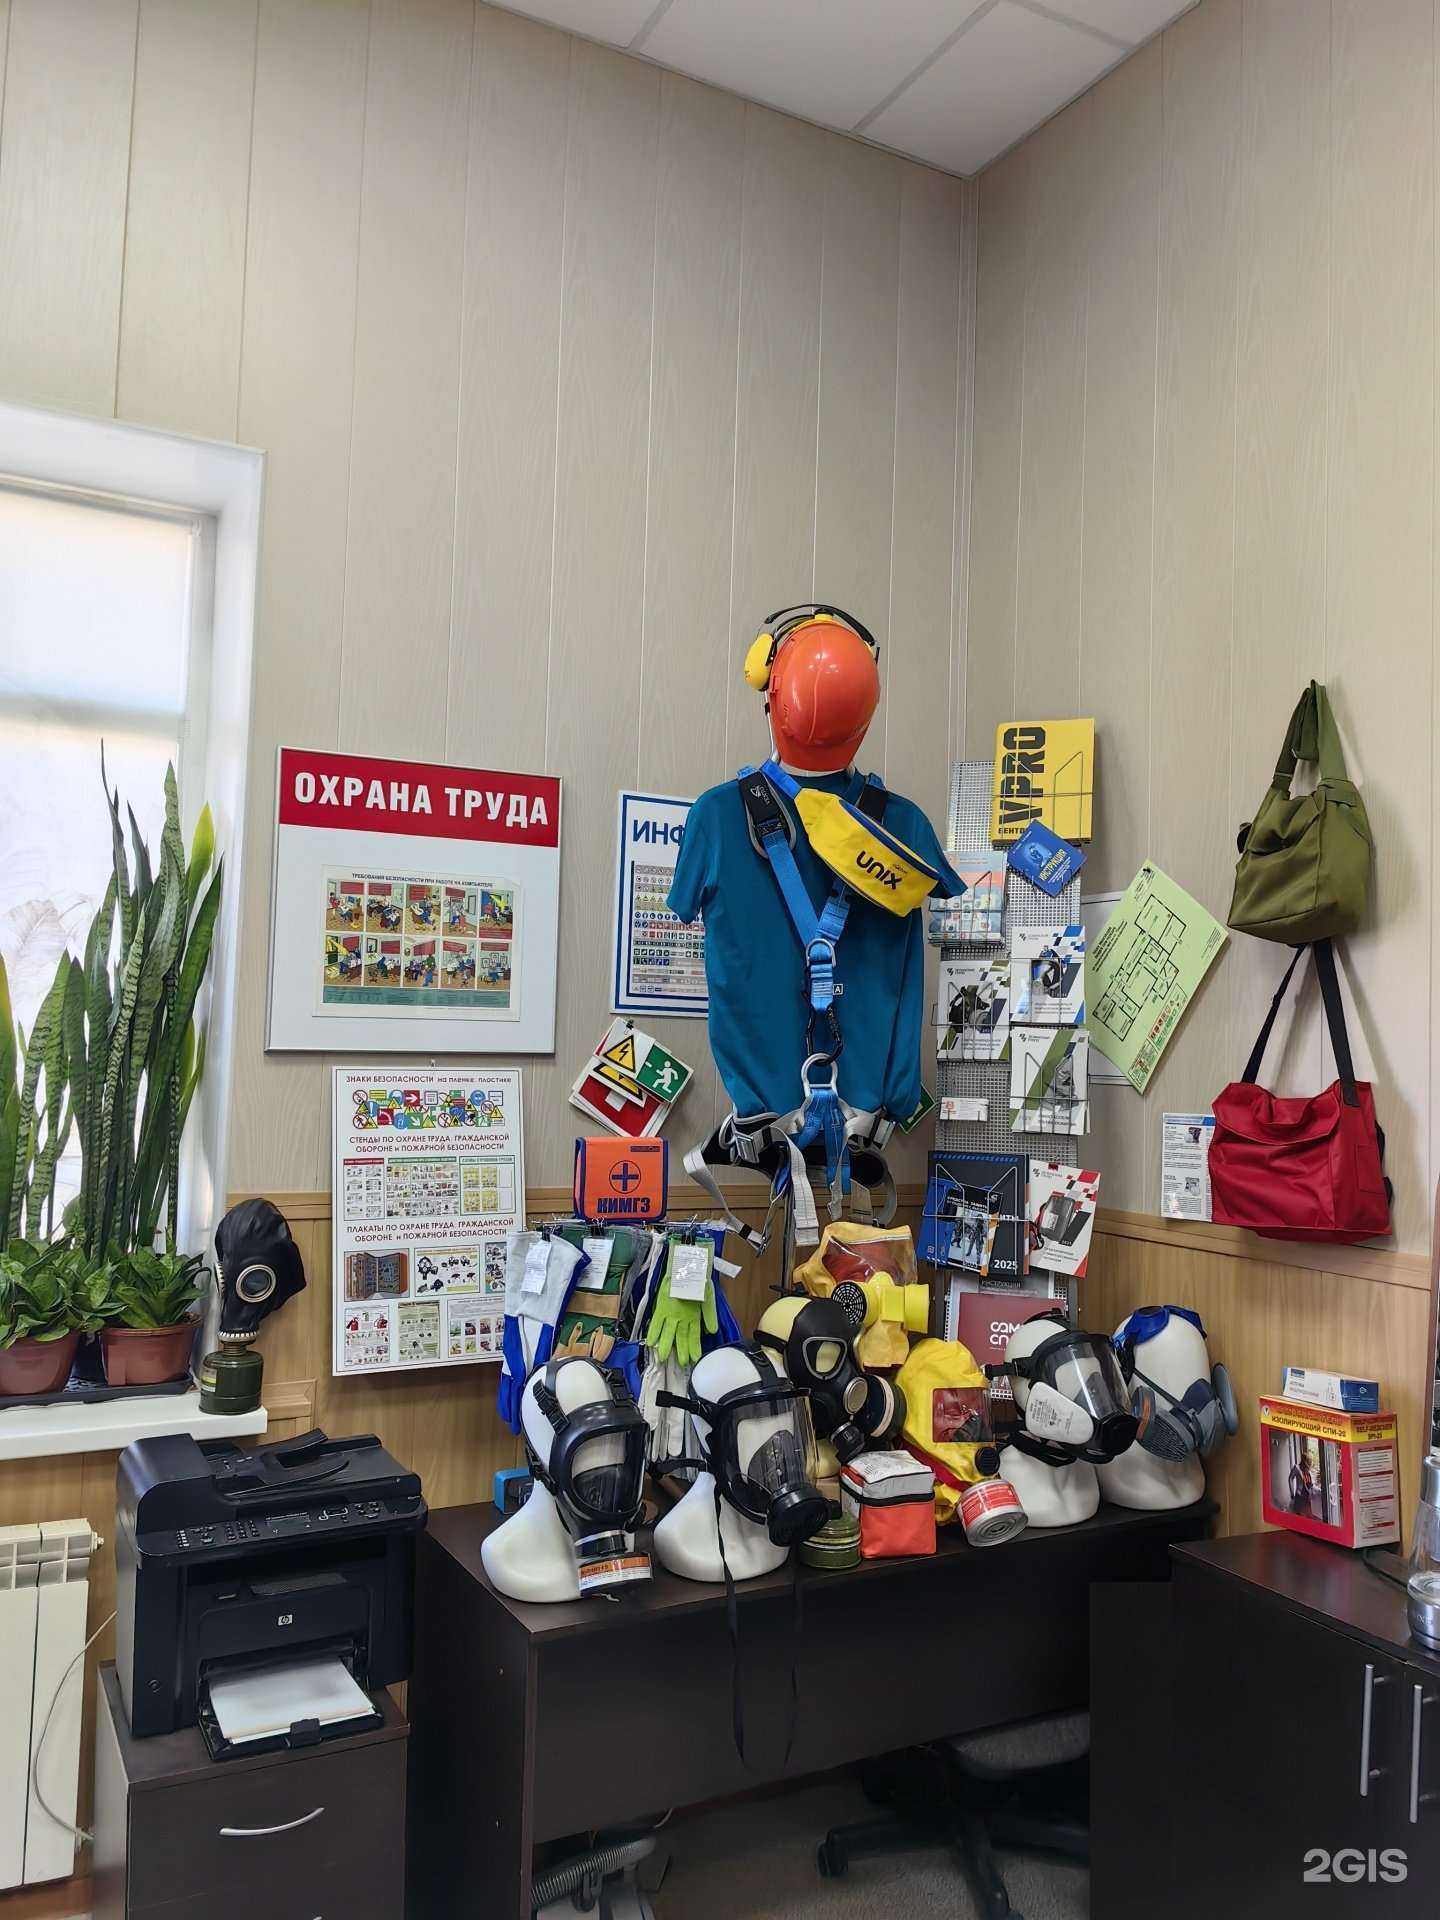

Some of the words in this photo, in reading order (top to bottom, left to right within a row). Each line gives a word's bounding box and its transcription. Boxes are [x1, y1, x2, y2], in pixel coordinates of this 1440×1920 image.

[999, 727, 1045, 824] VPRO
[295, 772, 432, 814] ОХРАНА
[445, 787, 548, 829] ТРУДА
[346, 1075, 372, 1083] ЗНАКИ
[374, 1075, 434, 1083] БЕЗОПАСНОСТИ
[350, 1136, 380, 1144] СТЕНДЫ
[383, 1135, 394, 1143] ПО
[396, 1135, 427, 1143] ОХРАНЕ
[455, 1132, 510, 1142] ГРАЖДАНСКОЙ
[356, 1145, 393, 1153] ОБОРОНЕ
[402, 1143, 446, 1152] ПОЖАРНОЙ
[447, 1143, 504, 1151] БЕЗОПАСНОСТИ
[597, 1197, 651, 1214] КИМГЗ
[347, 1225, 384, 1233] ПЛАКАТЫ
[400, 1222, 429, 1231] ОХРАНЕ
[458, 1217, 514, 1228] ГРАЖДАНСКОЙ
[355, 1233, 393, 1242] ОБОРОНЕ
[403, 1230, 448, 1240] ПОЖАРНОЙ
[449, 1228, 507, 1238] БЕЗОПАСНОСТИ
[994, 1259, 1017, 1270] 2025
[1271, 1415, 1321, 1433] ИЗОЛИРУЮЩИЙ
